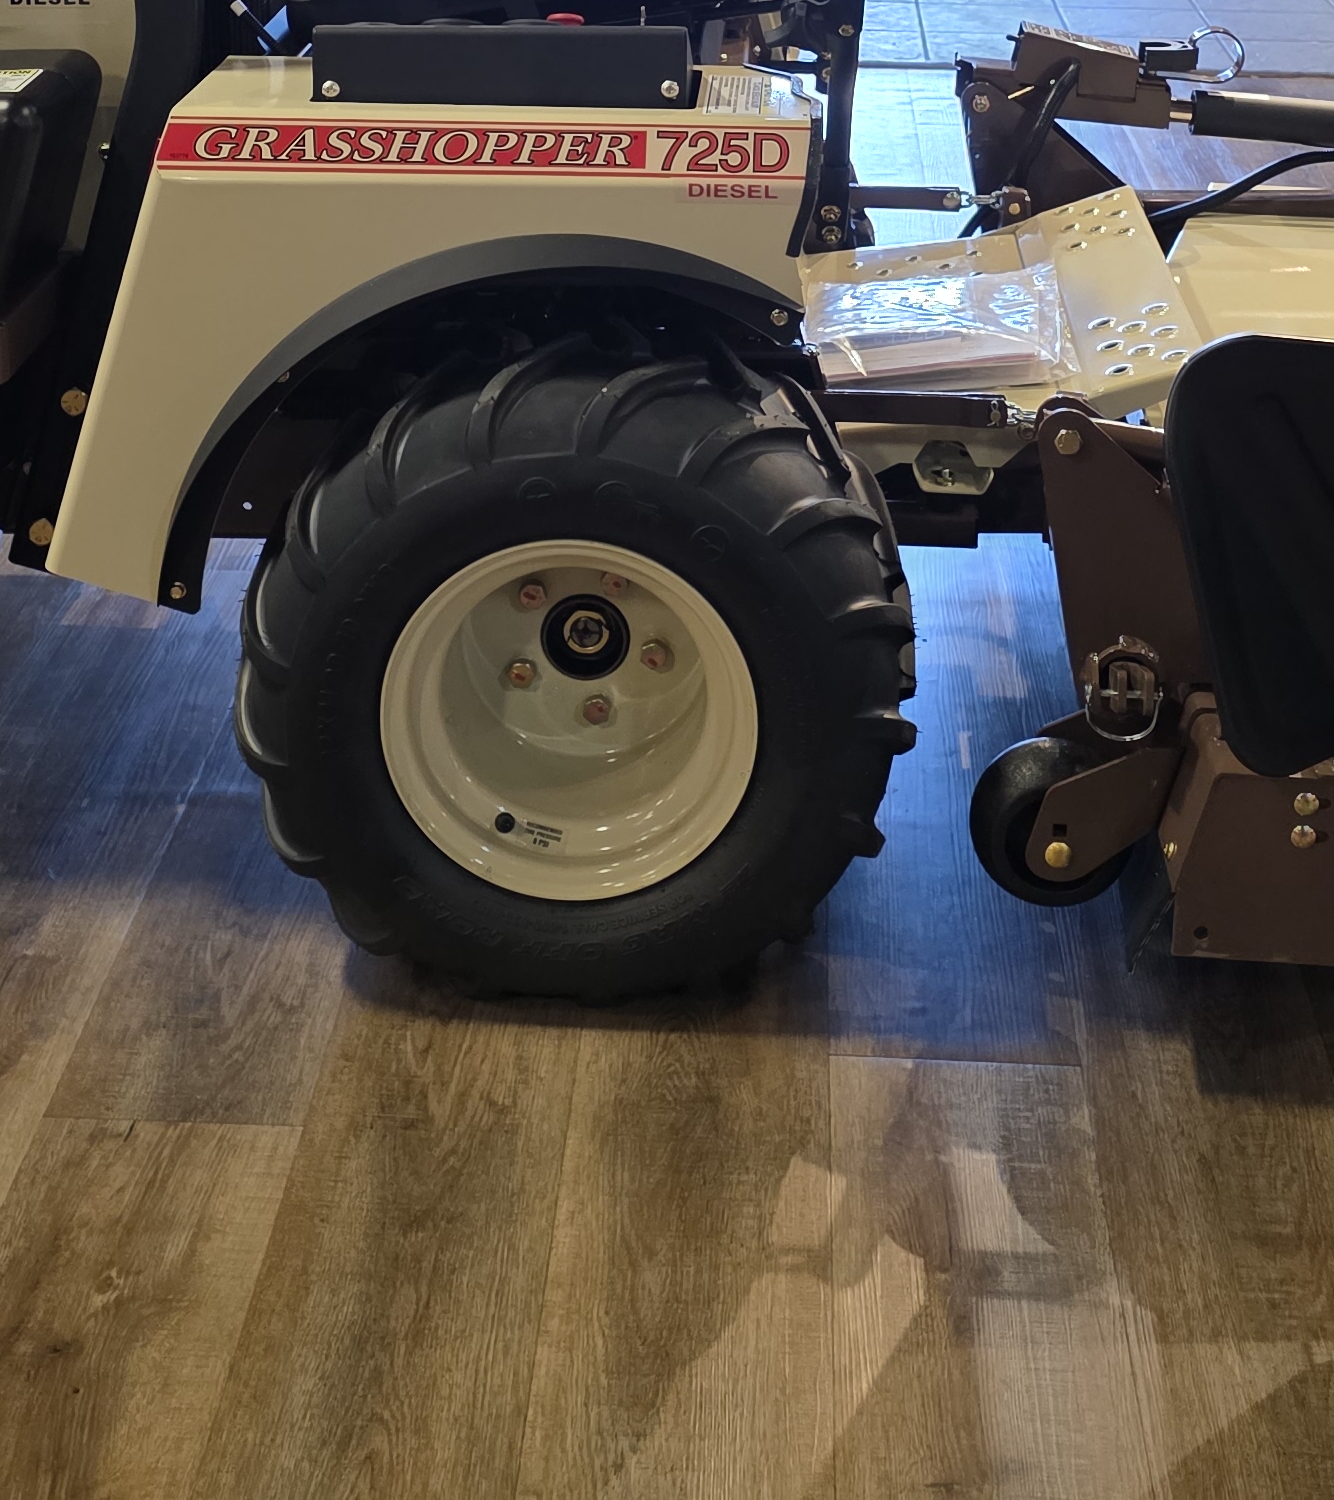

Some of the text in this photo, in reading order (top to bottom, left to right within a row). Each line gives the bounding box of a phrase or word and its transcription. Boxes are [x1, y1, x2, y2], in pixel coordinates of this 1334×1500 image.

[194, 126, 789, 173] GRASSHOPPER 725D
[688, 183, 778, 199] DIESEL
